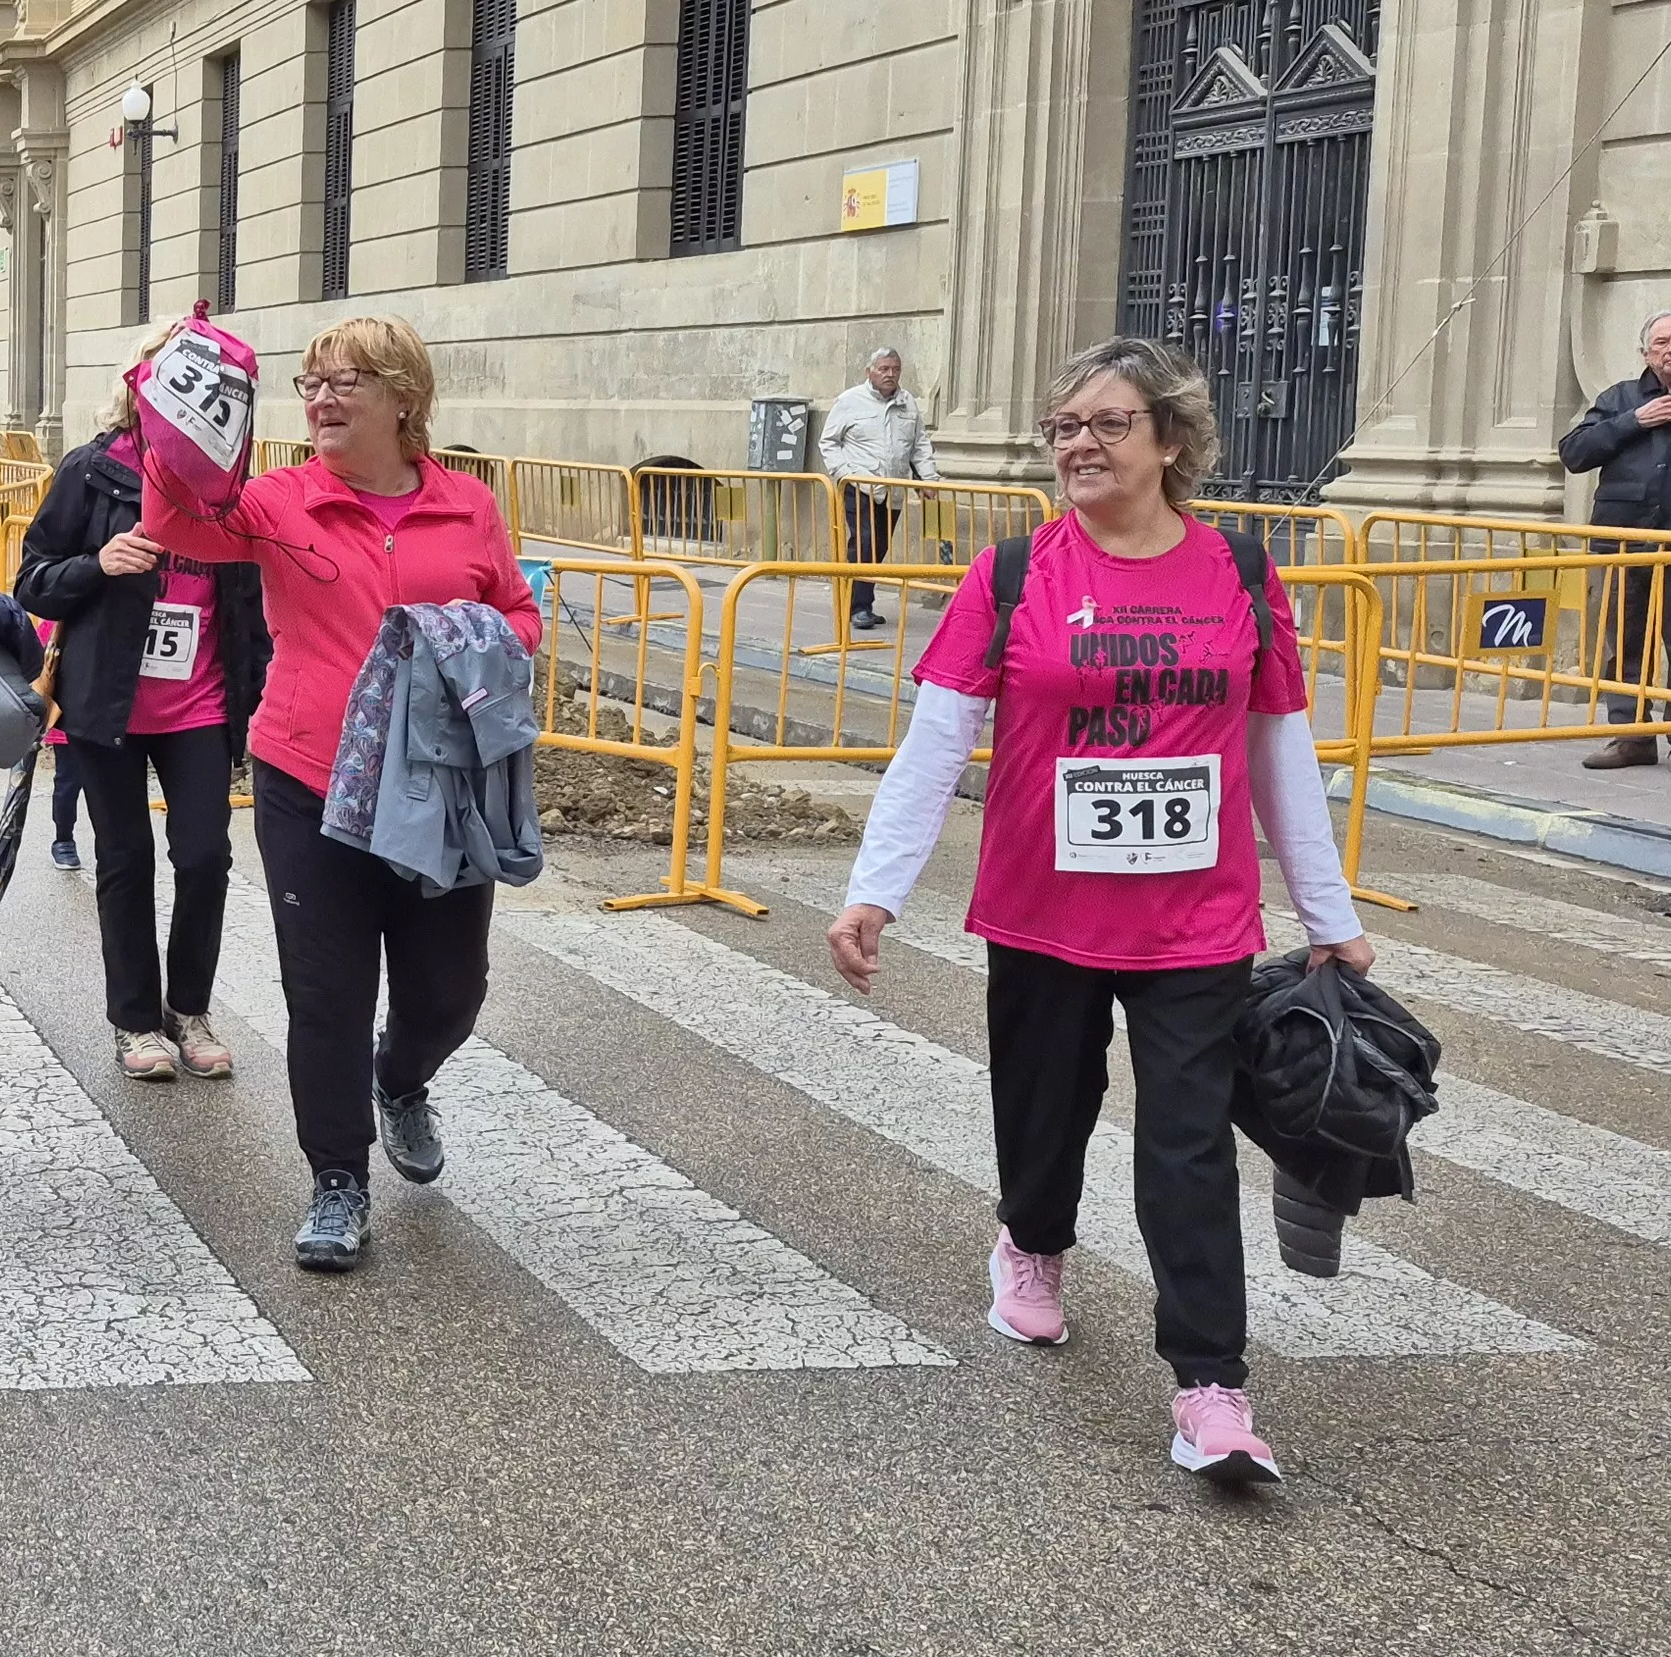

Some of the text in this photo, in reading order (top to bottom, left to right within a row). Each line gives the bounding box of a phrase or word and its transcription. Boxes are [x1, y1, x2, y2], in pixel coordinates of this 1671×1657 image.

[1116, 616, 1163, 625] CONTRA
[1165, 615, 1178, 625] EL
[1130, 605, 1183, 615] CARRERA
[1070, 632, 1179, 668] UNIDOS
[1115, 667, 1229, 706] EN CADA
[1068, 705, 1151, 748] PASO
[1075, 779, 1205, 792] CONTRA EL CÁNCER
[1122, 771, 1164, 780] HUESCA
[1091, 797, 1191, 840] 318
